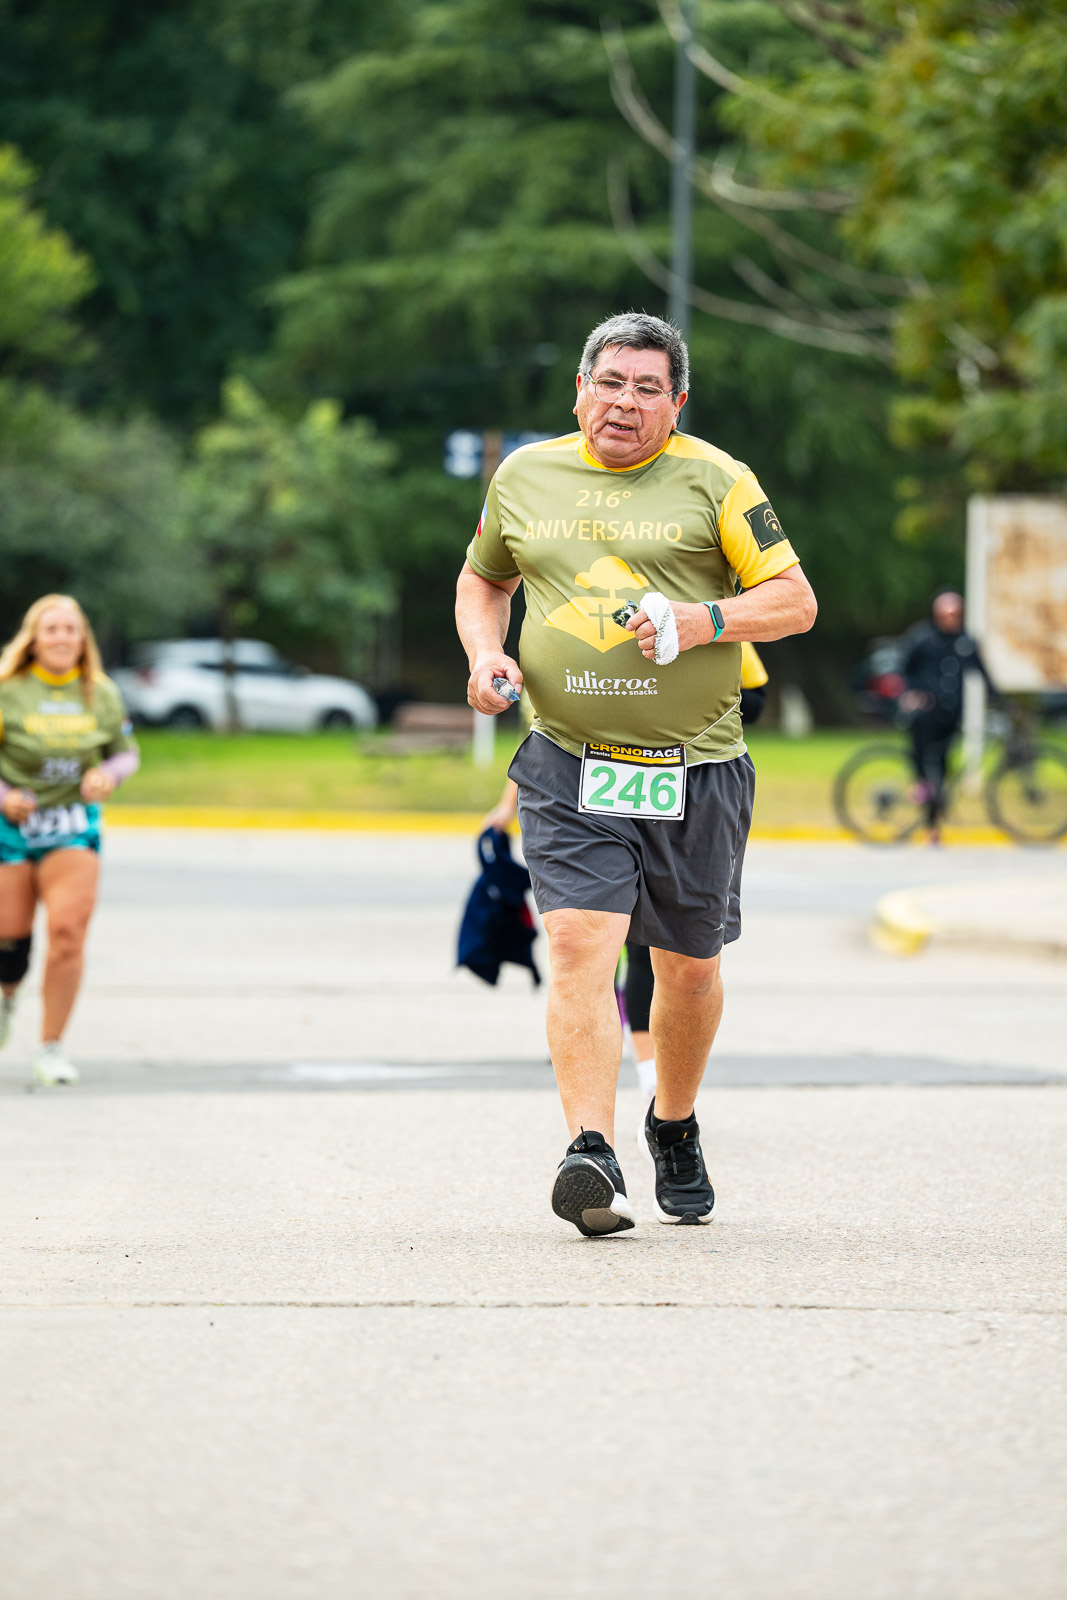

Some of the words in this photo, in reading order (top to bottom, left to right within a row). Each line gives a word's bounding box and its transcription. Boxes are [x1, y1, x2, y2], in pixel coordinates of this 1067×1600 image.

[575, 489, 632, 508] 216°
[523, 519, 683, 543] ANIVERSARIO
[564, 668, 658, 693] julicroc
[587, 765, 677, 811] 246
